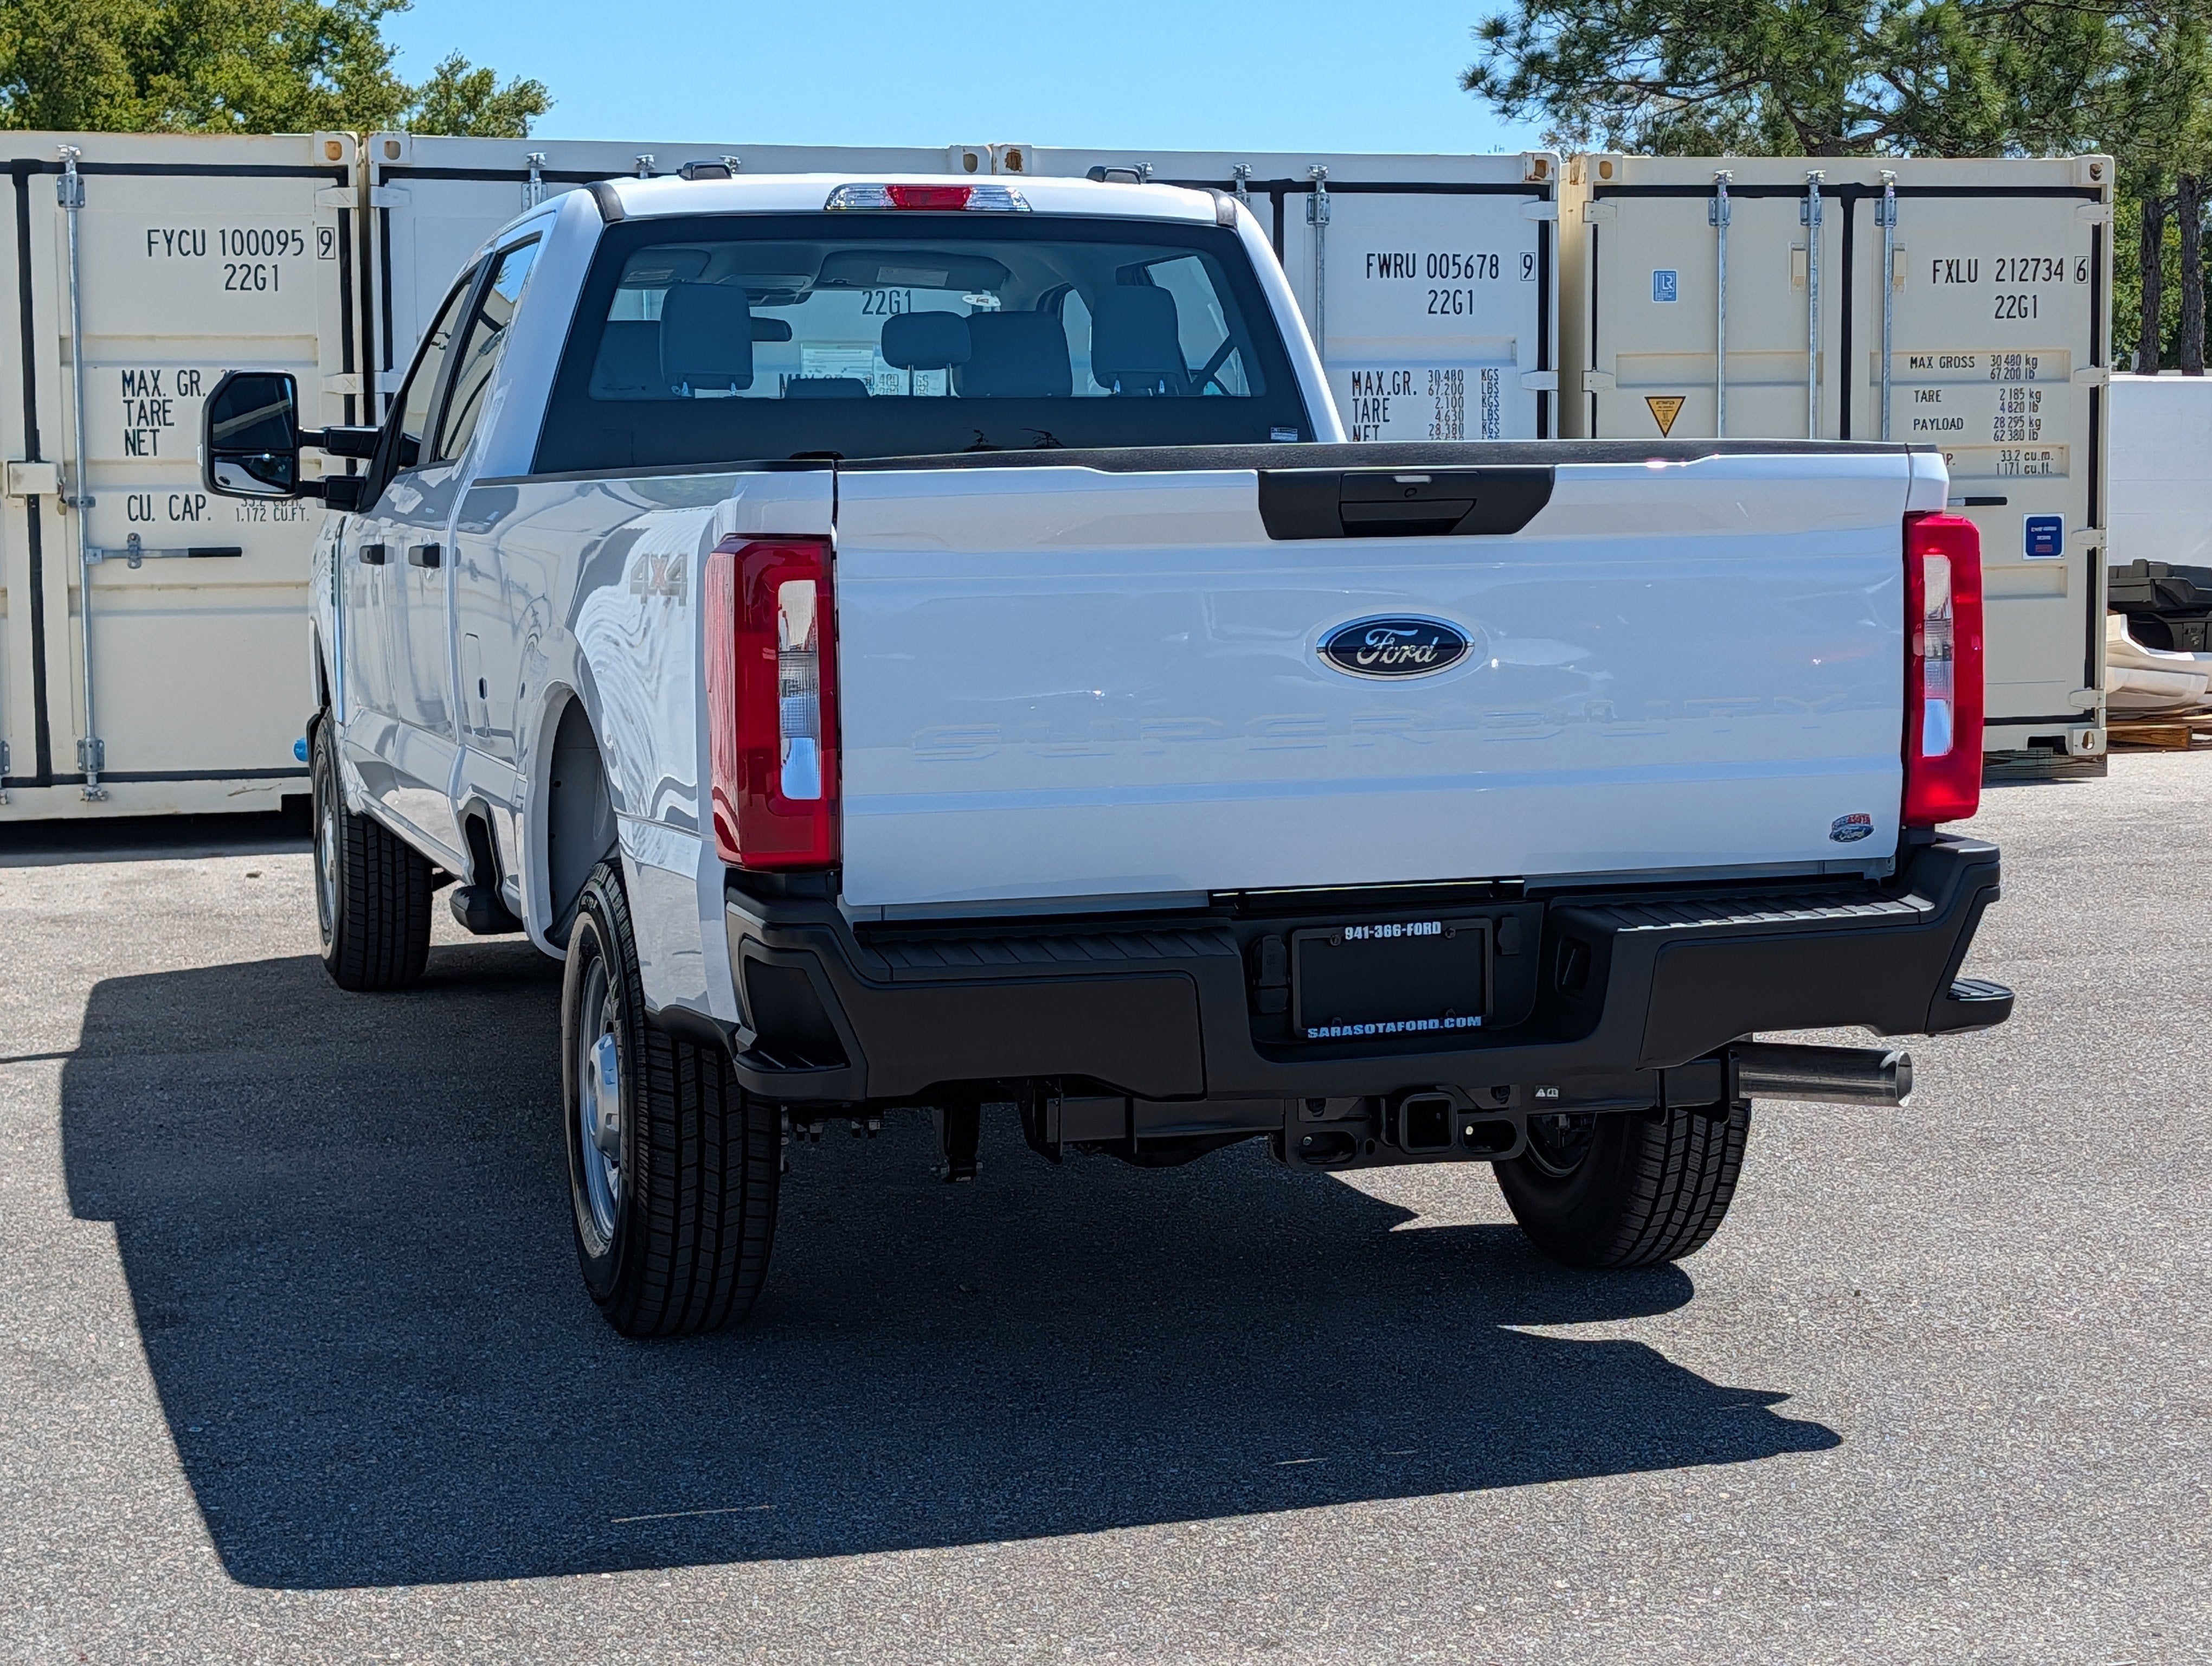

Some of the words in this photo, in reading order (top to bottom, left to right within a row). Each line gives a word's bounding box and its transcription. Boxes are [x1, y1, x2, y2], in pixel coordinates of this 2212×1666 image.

[147, 229, 206, 257] FYCU
[218, 228, 305, 257] 100095
[319, 230, 332, 256] 9
[224, 264, 279, 292] 22G1
[1366, 253, 1416, 279] FWRU
[1427, 253, 1500, 279] 005678
[1522, 254, 1534, 279] 9
[1932, 258, 1978, 284] FXLU
[1995, 258, 2064, 282] 212734
[2076, 259, 2087, 281] 6
[862, 290, 911, 315] 22G1
[1427, 289, 1474, 315] 22G1
[1994, 294, 2038, 319] 22G1
[1910, 356, 1933, 369] MAX
[1939, 356, 1975, 369] GROSS
[2025, 354, 2038, 370] kg
[177, 369, 205, 397] GR.
[1481, 381, 1500, 395] LBS
[1914, 390, 1941, 403] TARE
[2009, 387, 2025, 400] 185
[2029, 387, 2042, 403] kg
[123, 399, 175, 427] TARE
[1352, 398, 1390, 423] TARE
[1481, 408, 1500, 421] LBS
[1913, 418, 1964, 431] PAYLOAD
[1993, 416, 2005, 429] 28
[2028, 415, 2041, 431] kg
[124, 429, 161, 457] NET
[127, 496, 156, 522] CU.
[168, 495, 211, 522] CAP.
[236, 507, 267, 522] 1.172
[1356, 628, 1438, 665] Ford
[1345, 922, 1442, 940] 941-366-FORD
[1308, 1016, 1482, 1038] SARASOTAFORD.COM
